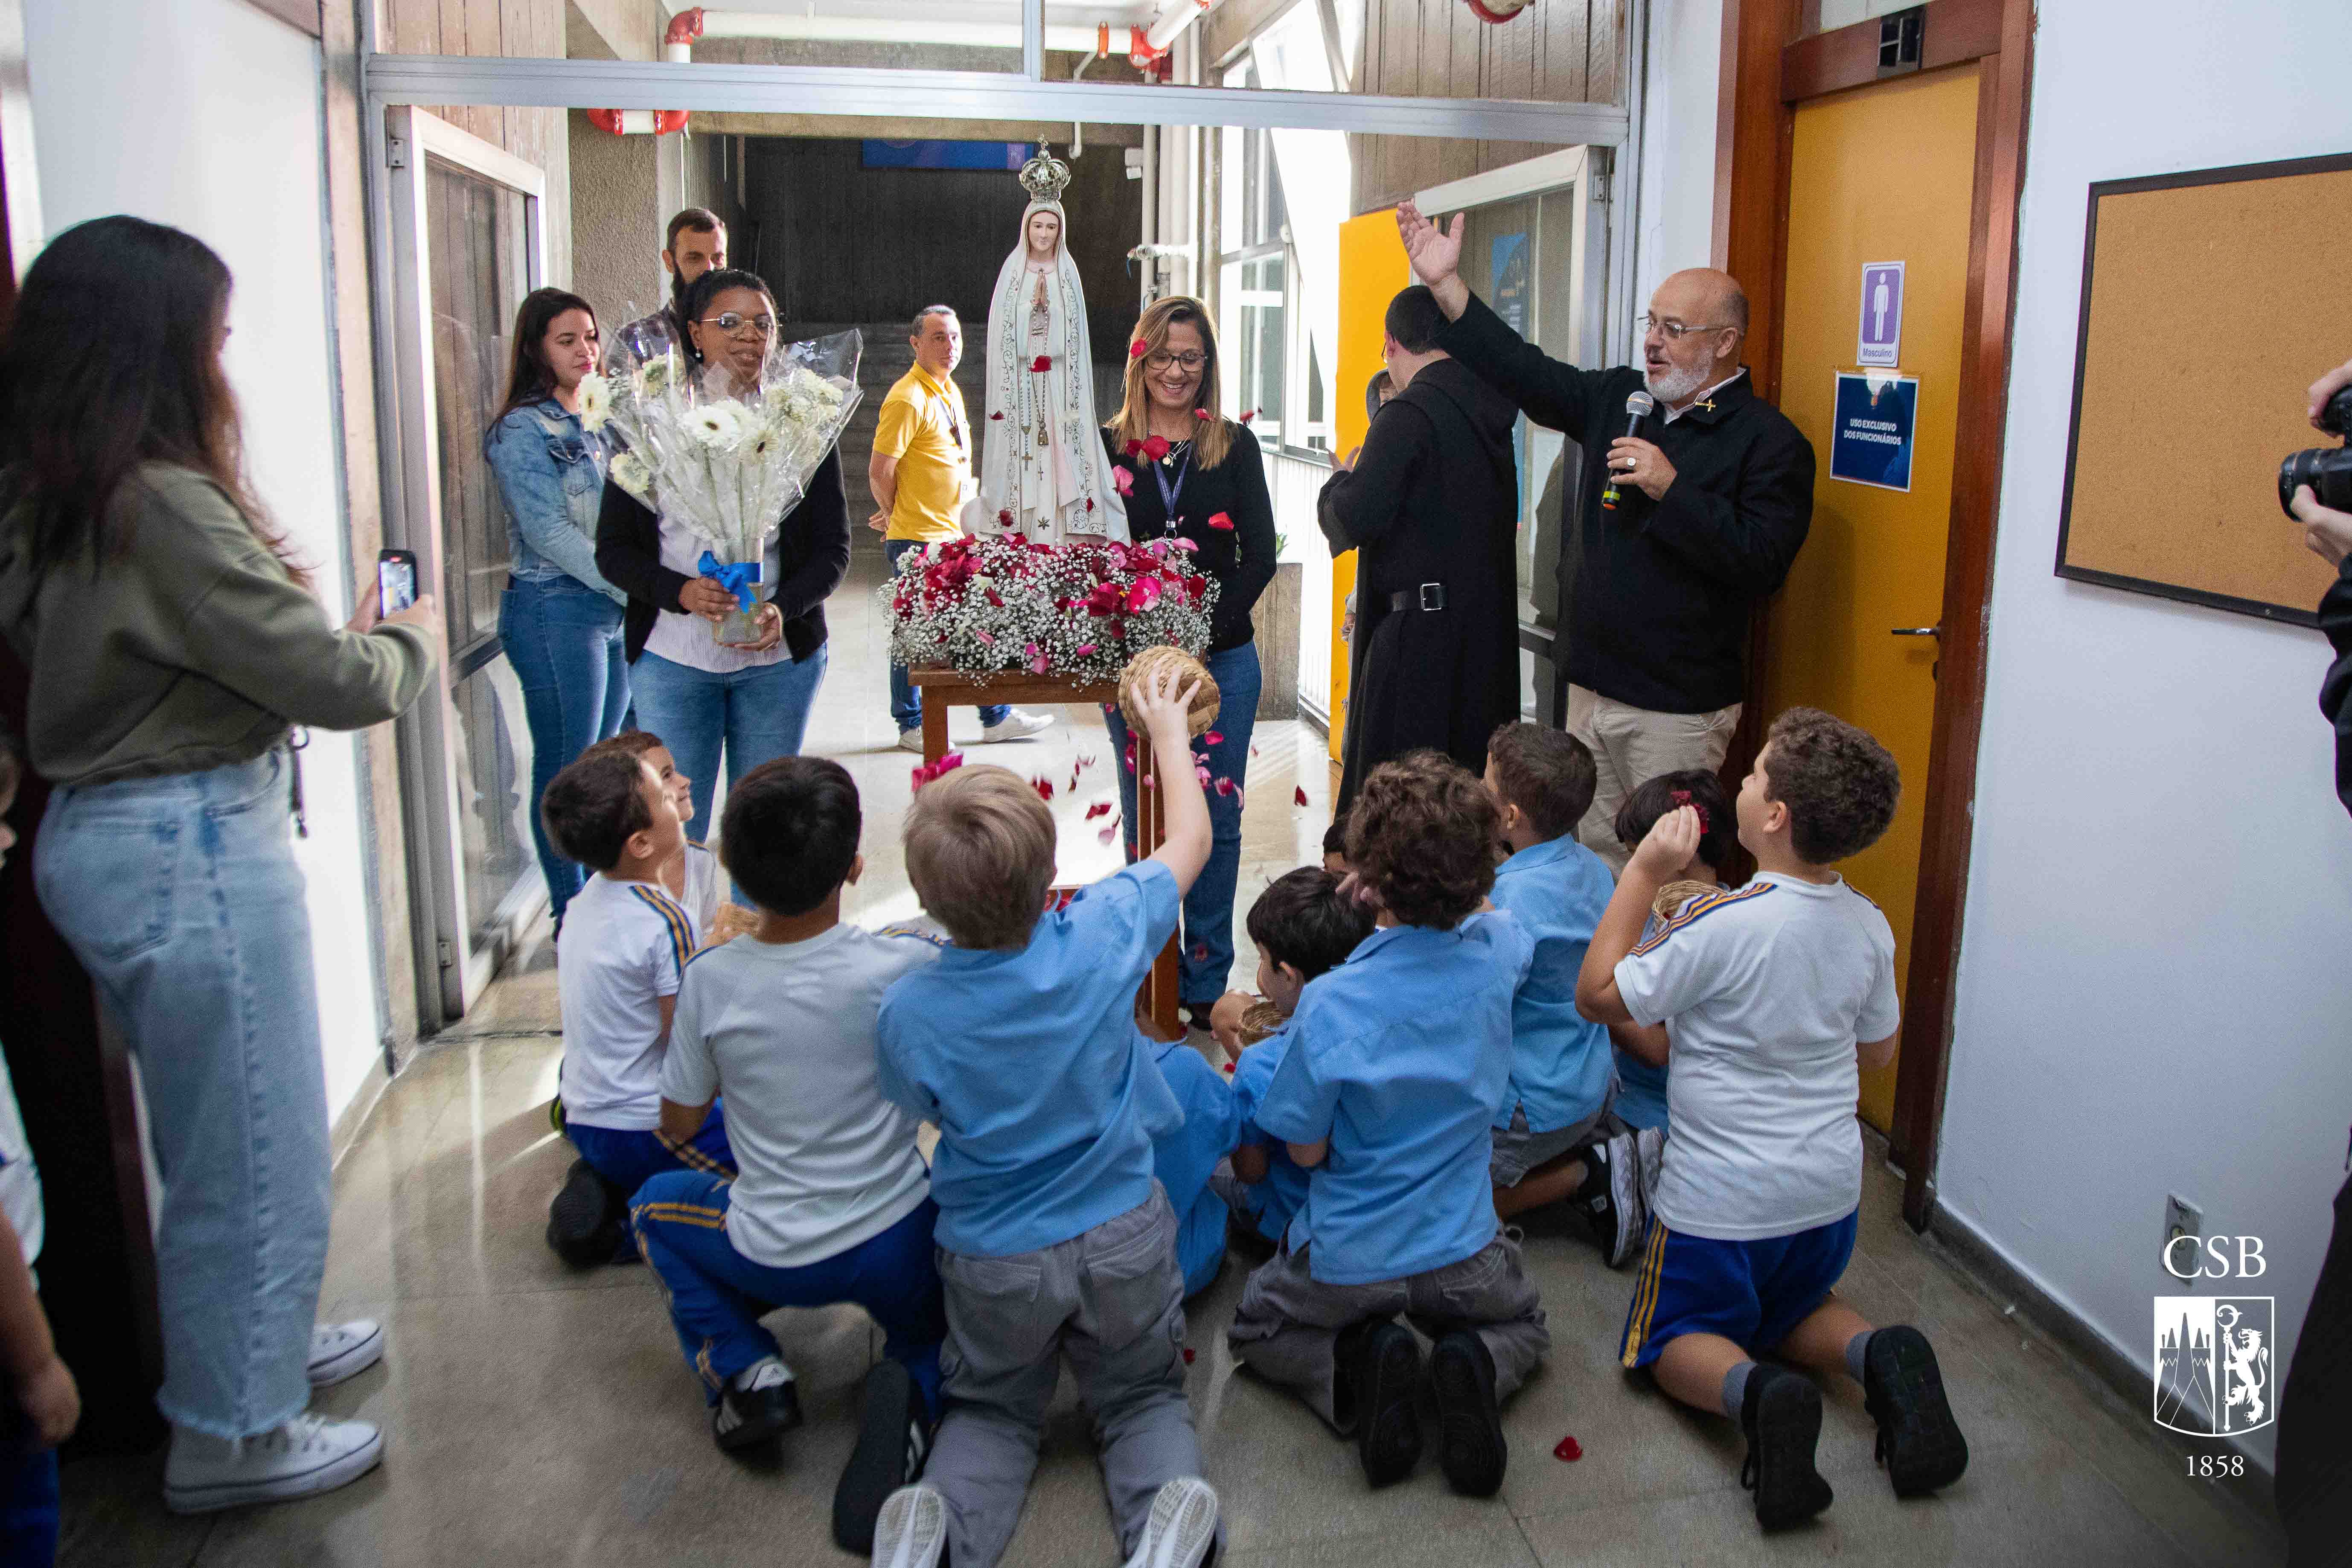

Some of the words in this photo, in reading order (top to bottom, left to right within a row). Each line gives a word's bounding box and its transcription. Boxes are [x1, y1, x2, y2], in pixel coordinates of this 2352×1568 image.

[1863, 348, 1892, 358] Masculino
[1850, 418, 1862, 428] USO
[1862, 419, 1897, 432] EXCLUSIVO
[1844, 430, 1856, 439] DOS
[1856, 432, 1902, 445] FUNCIONÁRIOS
